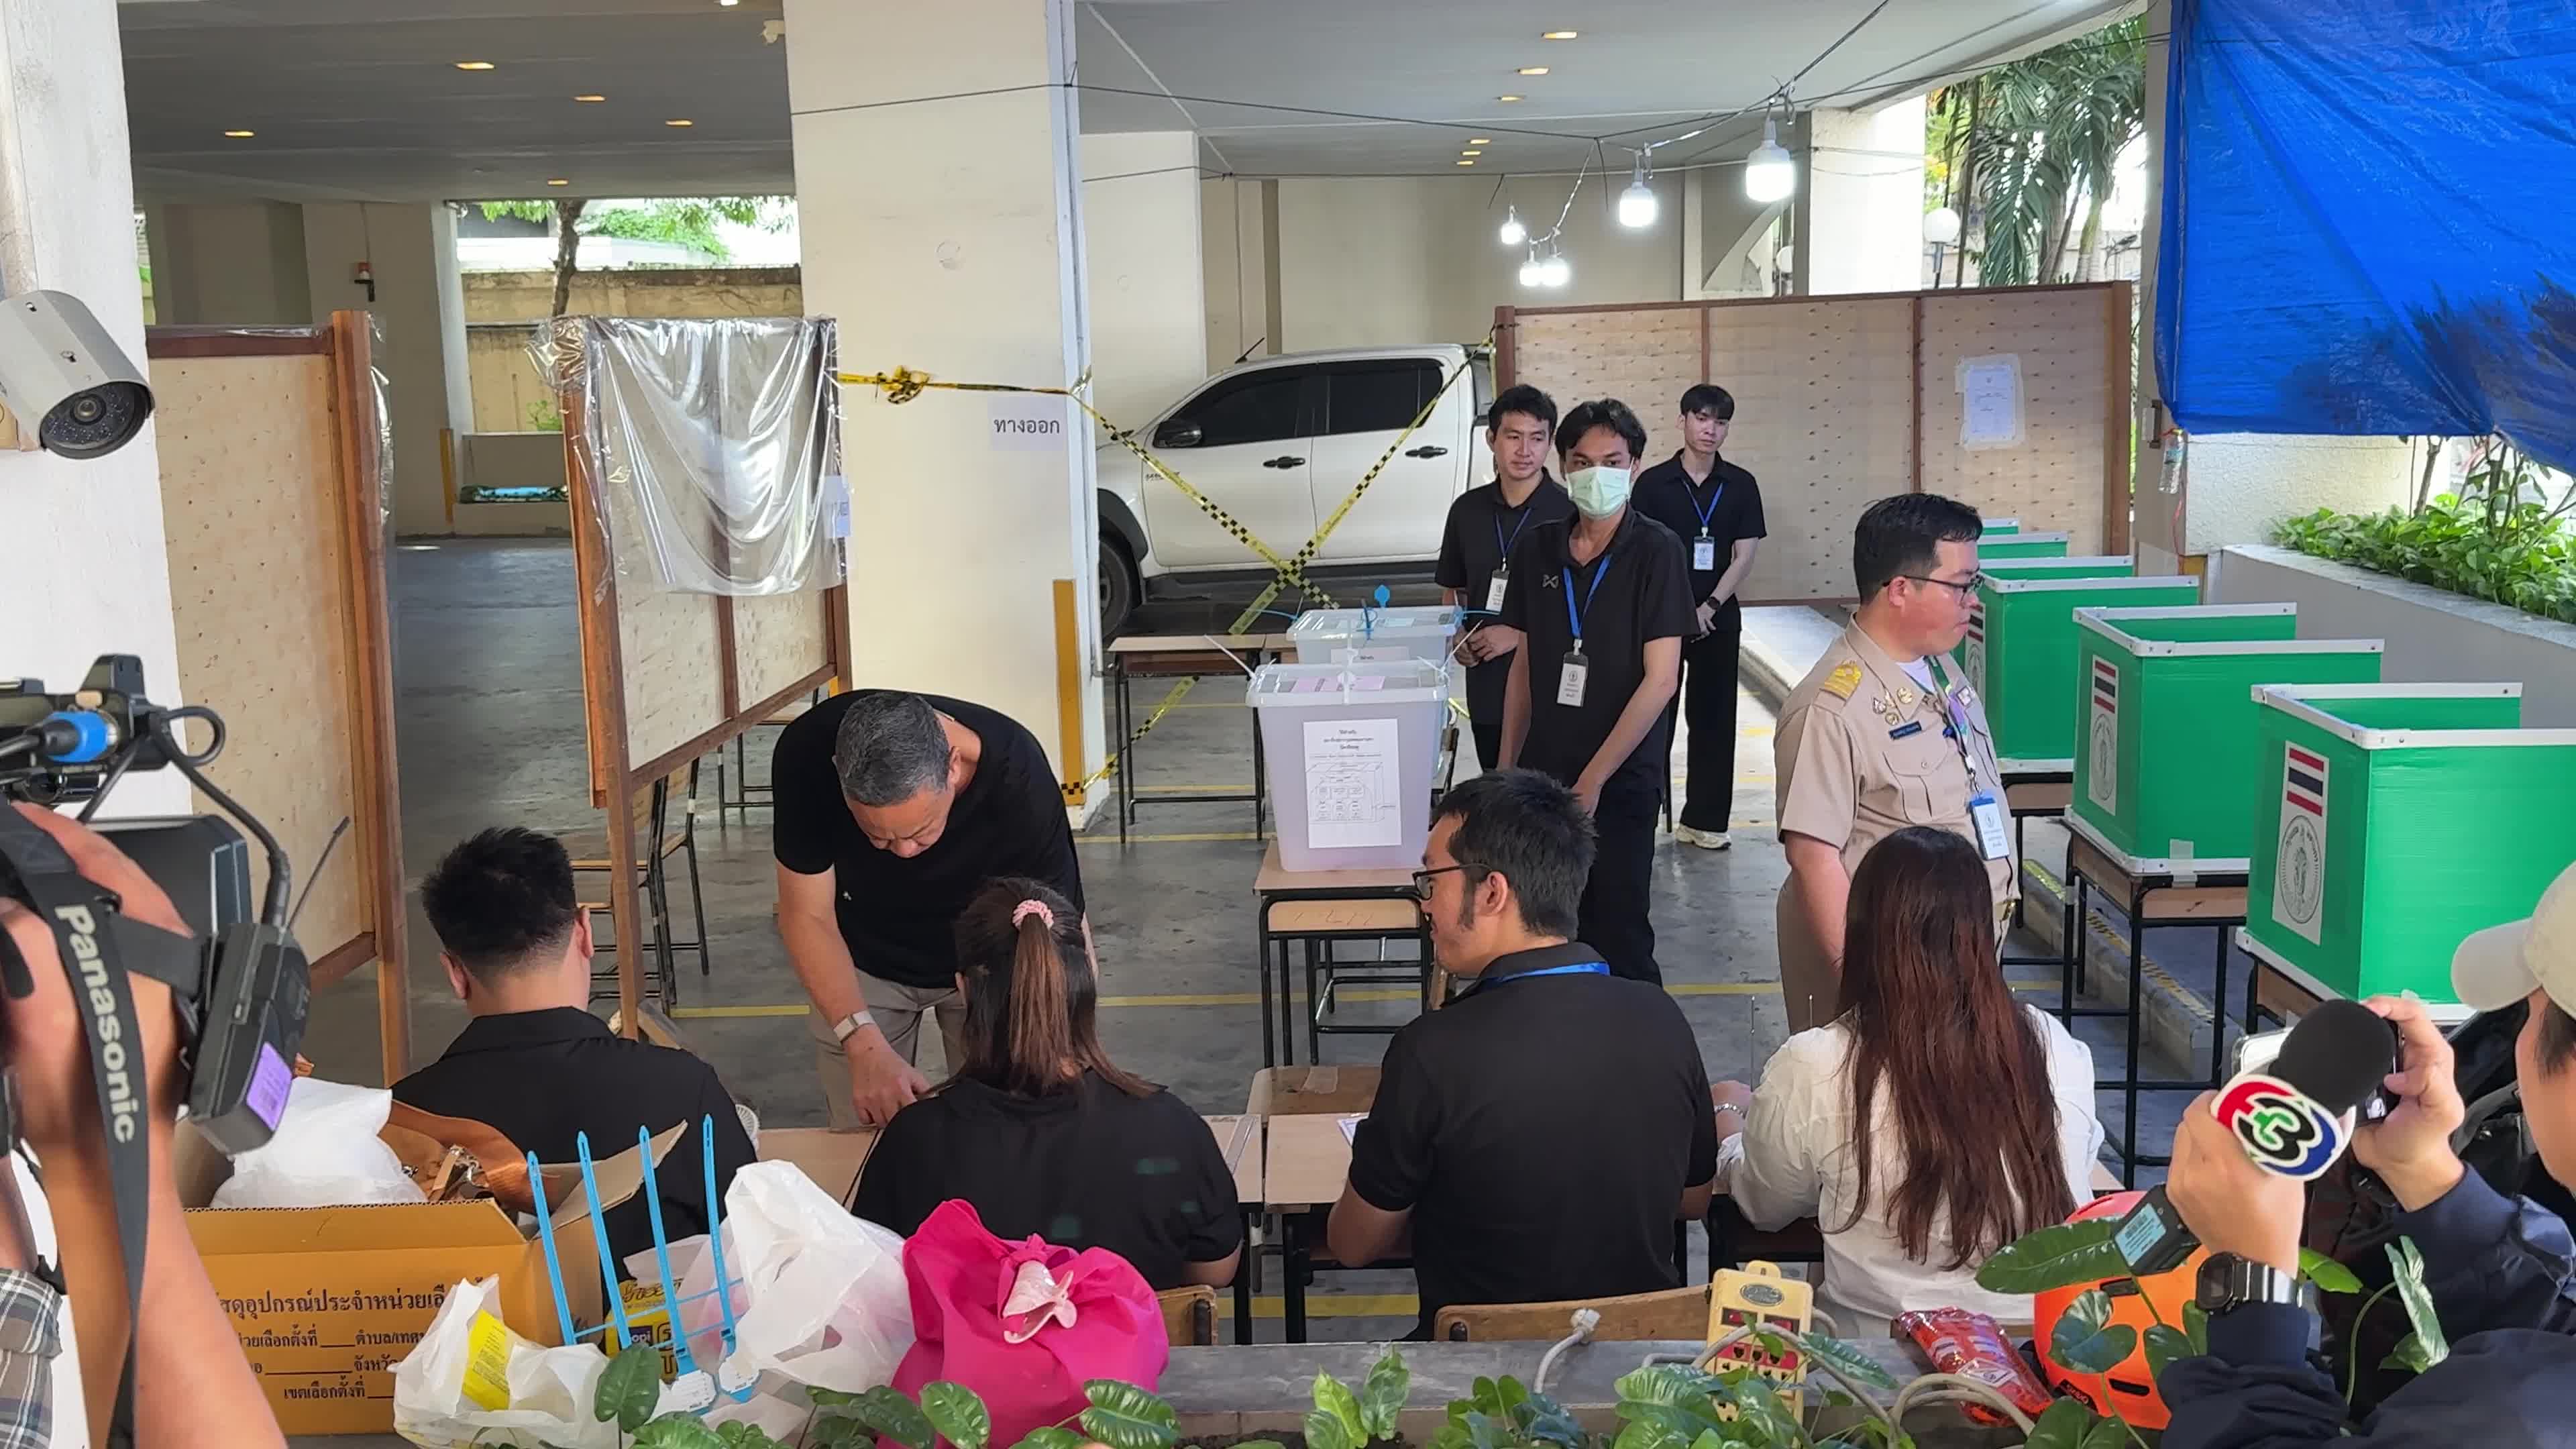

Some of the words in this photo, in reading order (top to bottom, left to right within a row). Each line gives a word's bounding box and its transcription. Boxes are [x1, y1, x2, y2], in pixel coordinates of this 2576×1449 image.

[994, 419, 1060, 434] ทางออก
[55, 904, 138, 1143] Panasonic
[284, 1375, 365, 1399] เขตเลือกตั้งที่
